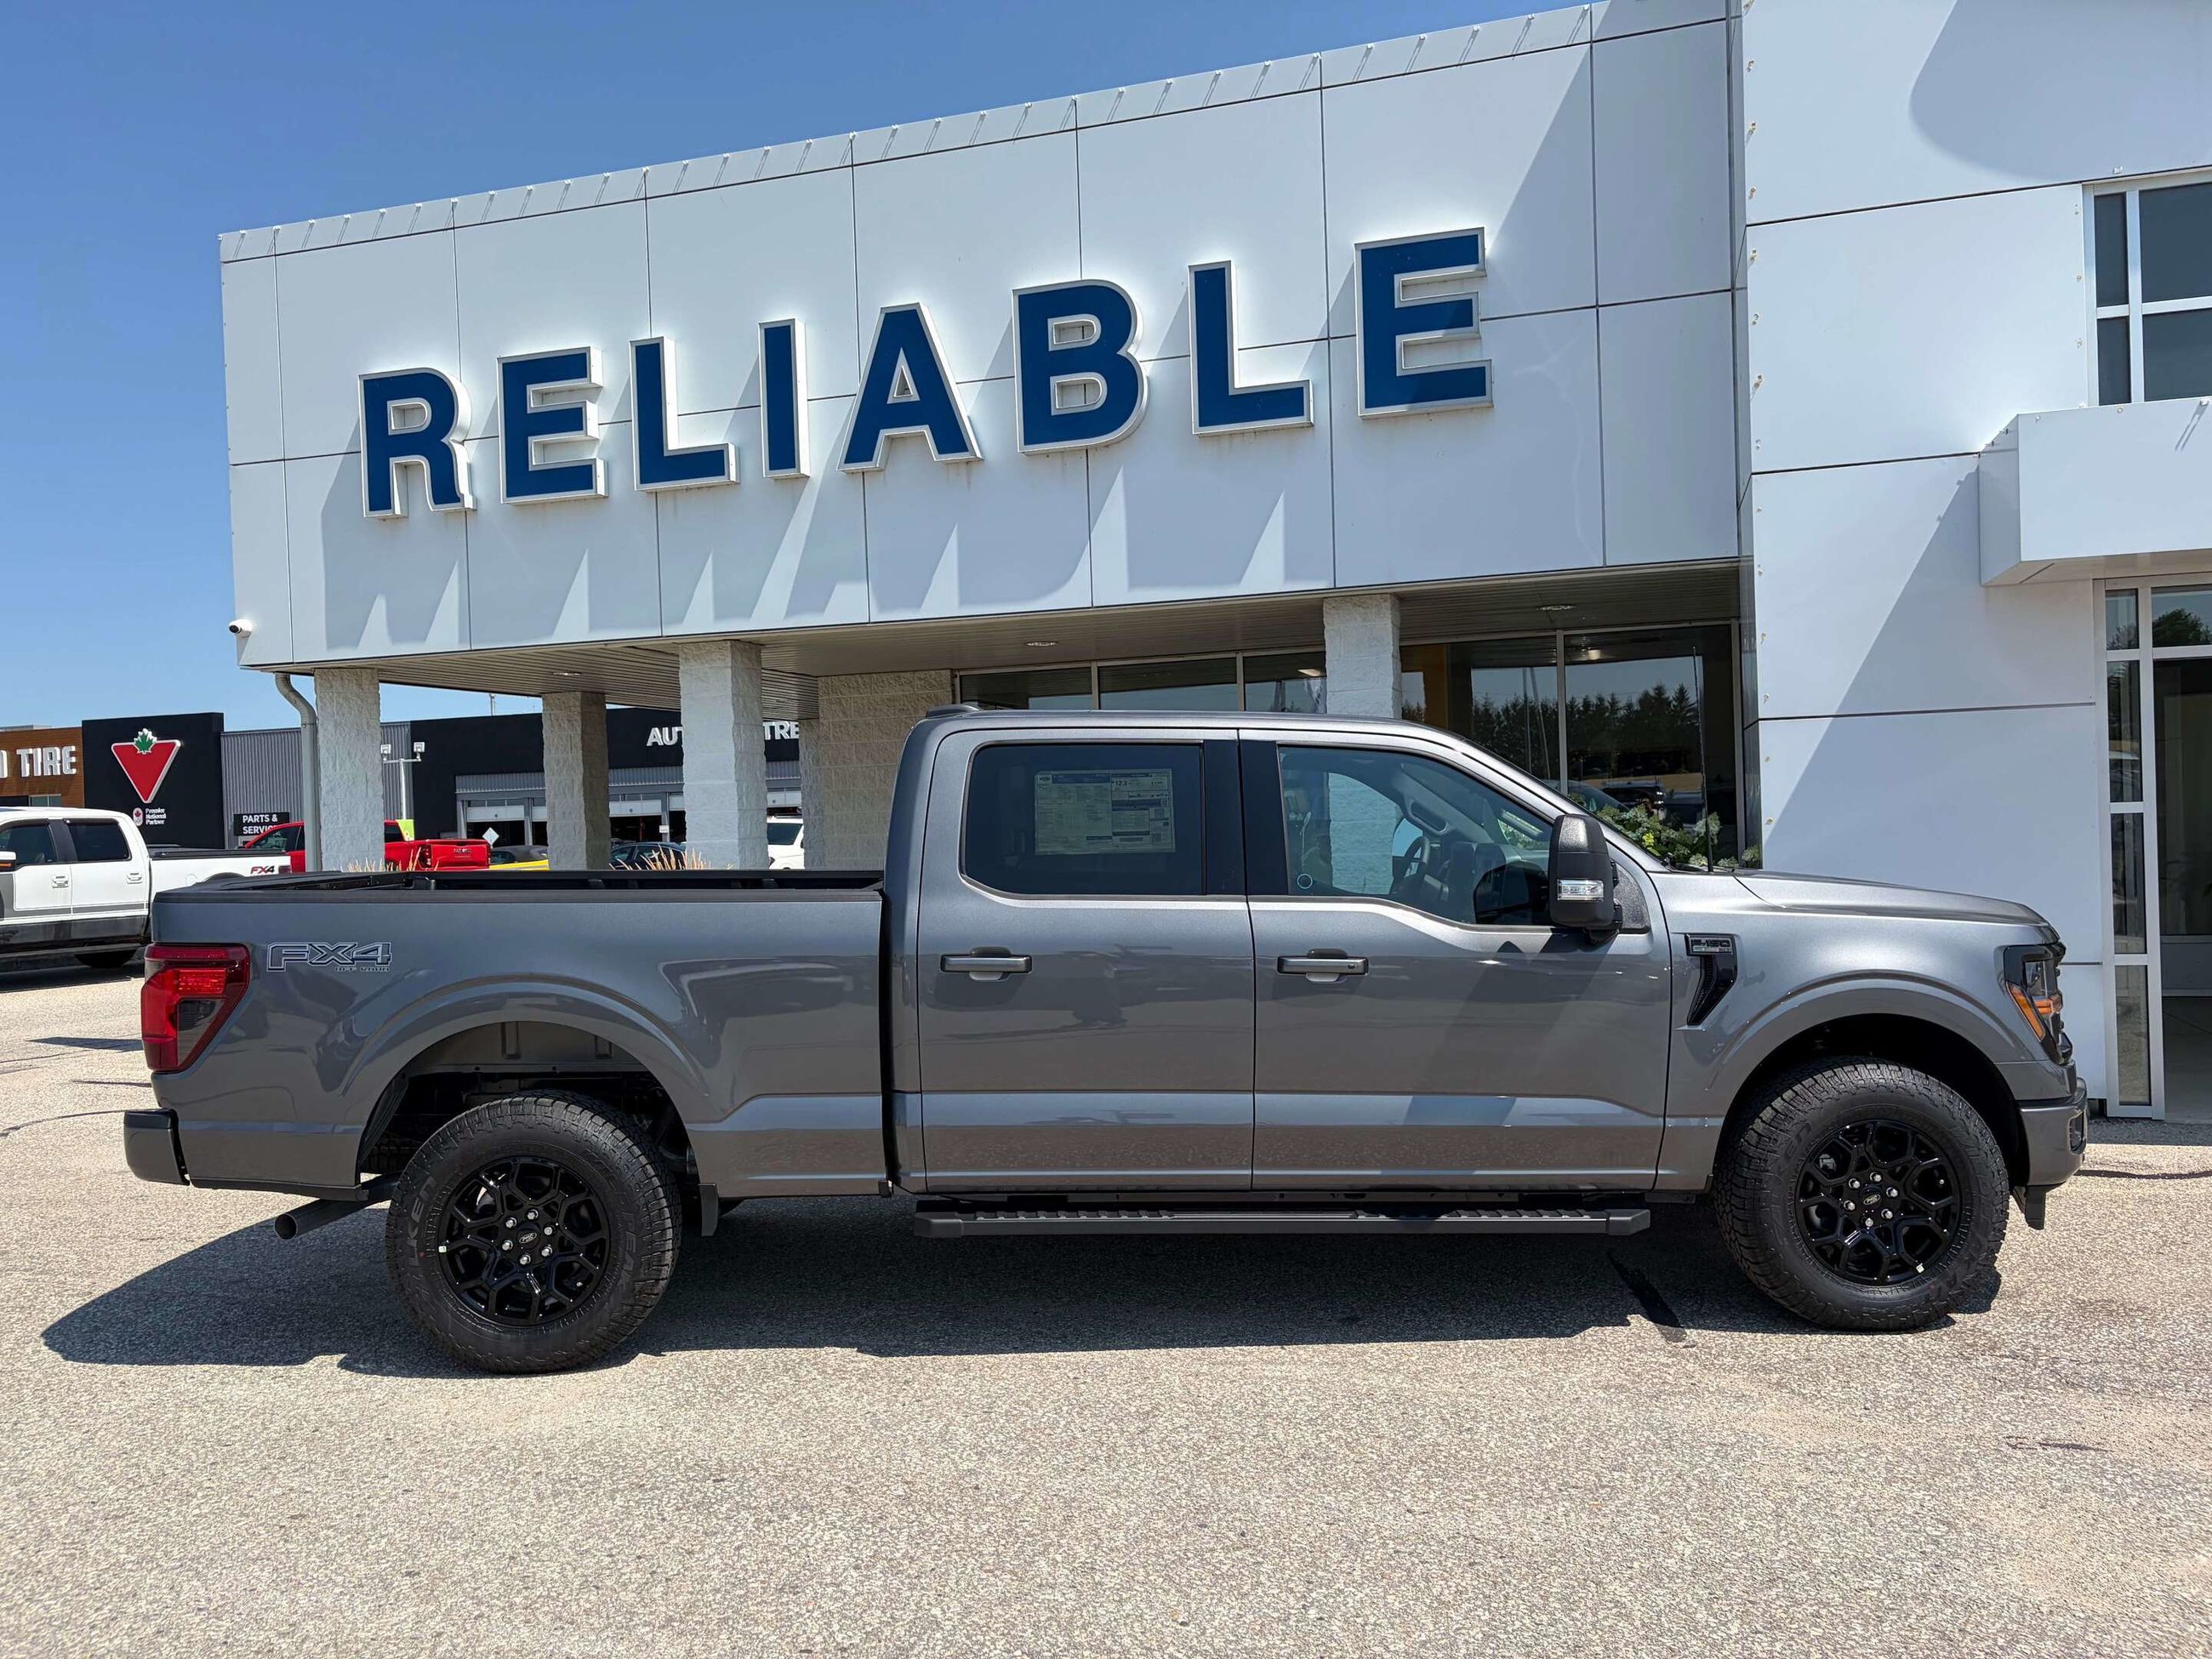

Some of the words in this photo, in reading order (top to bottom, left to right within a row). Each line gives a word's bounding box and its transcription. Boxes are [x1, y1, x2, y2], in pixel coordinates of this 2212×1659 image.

[357, 226, 1494, 521] RELIABLE
[16, 745, 77, 778] TIRE
[242, 814, 270, 823] PARTS
[251, 865, 276, 874] FX4
[266, 942, 392, 972] FX4
